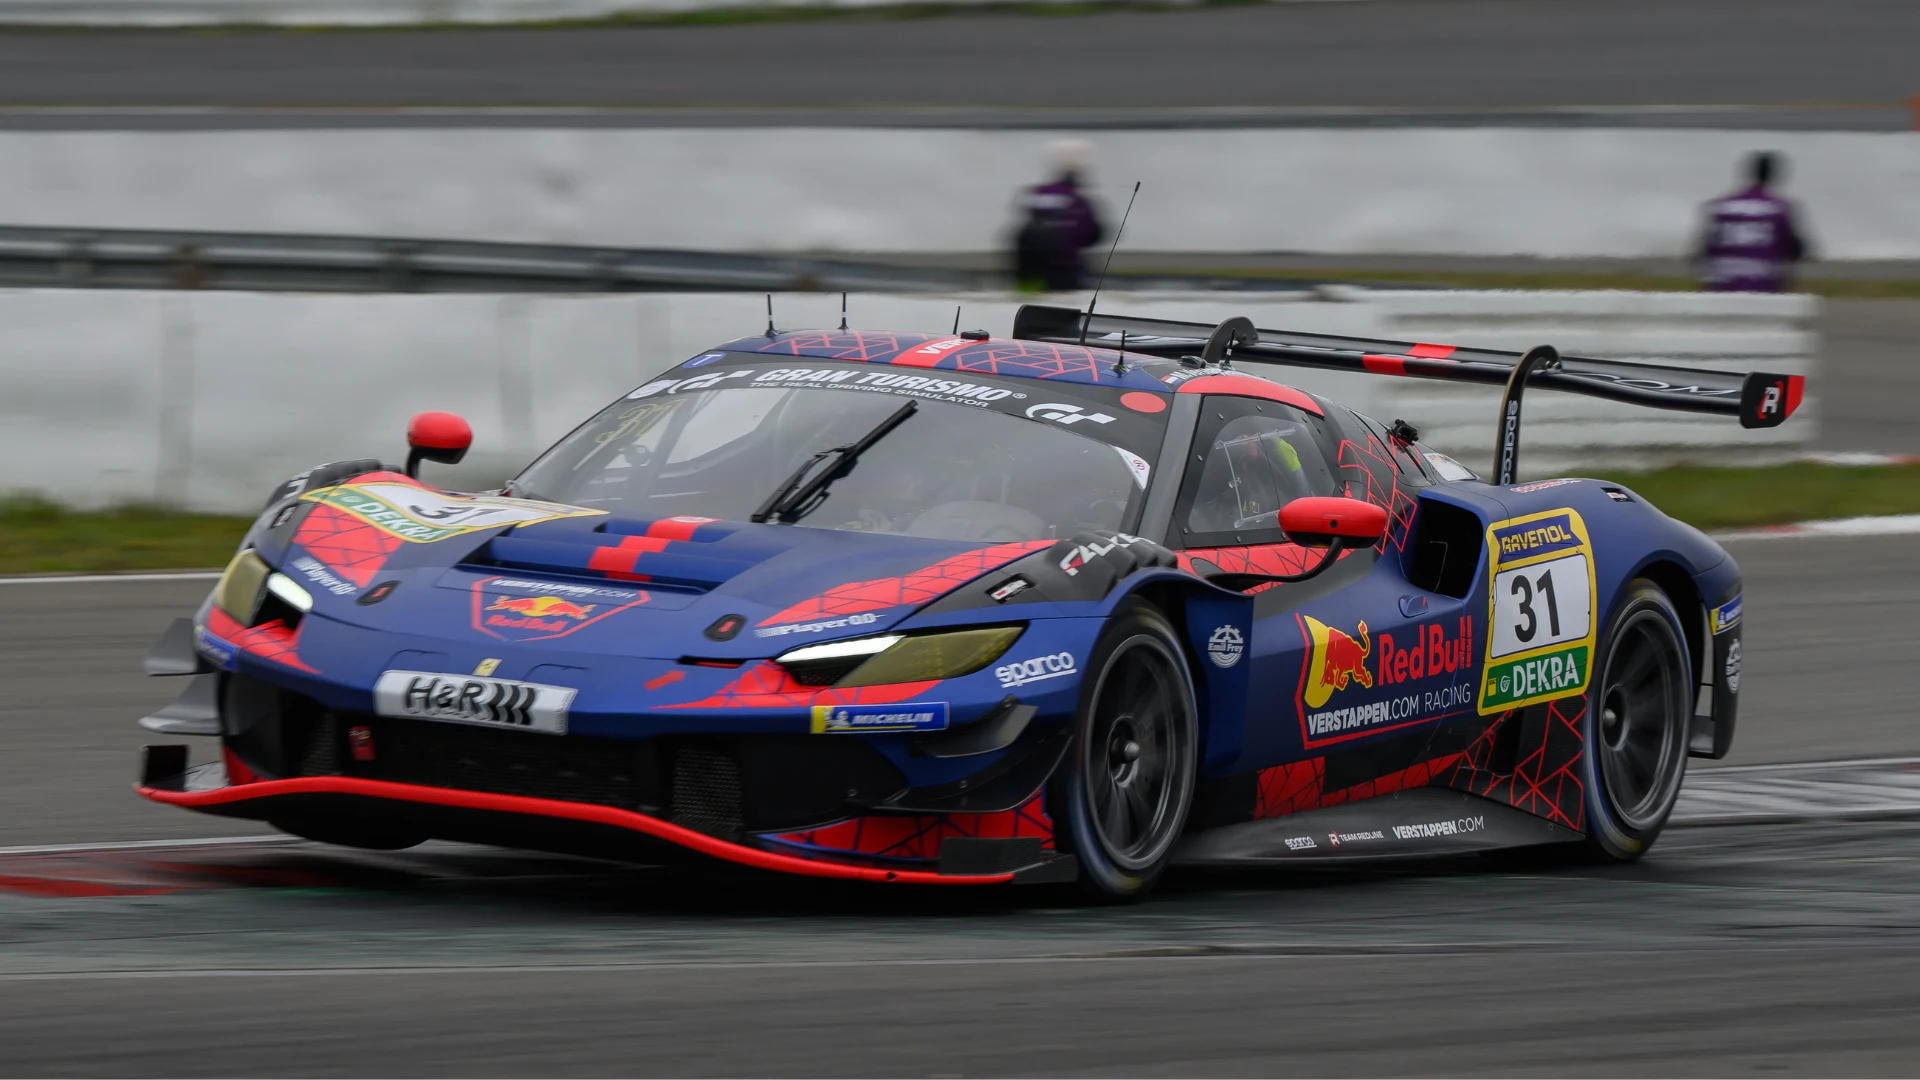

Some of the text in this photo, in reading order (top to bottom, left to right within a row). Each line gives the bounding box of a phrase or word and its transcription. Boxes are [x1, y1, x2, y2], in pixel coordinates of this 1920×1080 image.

[754, 368, 858, 384] GRAN
[783, 381, 823, 389] REAL
[826, 383, 893, 393] DRIVING
[896, 389, 989, 408] SIMULATOR
[1502, 400, 1519, 486] sparco
[351, 501, 446, 541] DEKRA
[407, 504, 507, 524] 31
[1501, 524, 1572, 554] RAVENOL
[1511, 568, 1560, 642] 31
[1227, 643, 1244, 654] Frey
[1378, 615, 1473, 687] Red Bull
[995, 652, 1076, 687] sparco
[1513, 653, 1580, 698] DEKRA
[851, 711, 935, 725] MICHELIN
[1307, 683, 1471, 736] VERSTAPPEN.COM RACING
[1339, 833, 1358, 842] TEAM
[1357, 831, 1384, 840] REDLINE
[1392, 815, 1485, 840] VERSTAPPEN.COM
[1284, 836, 1315, 850] sparco
